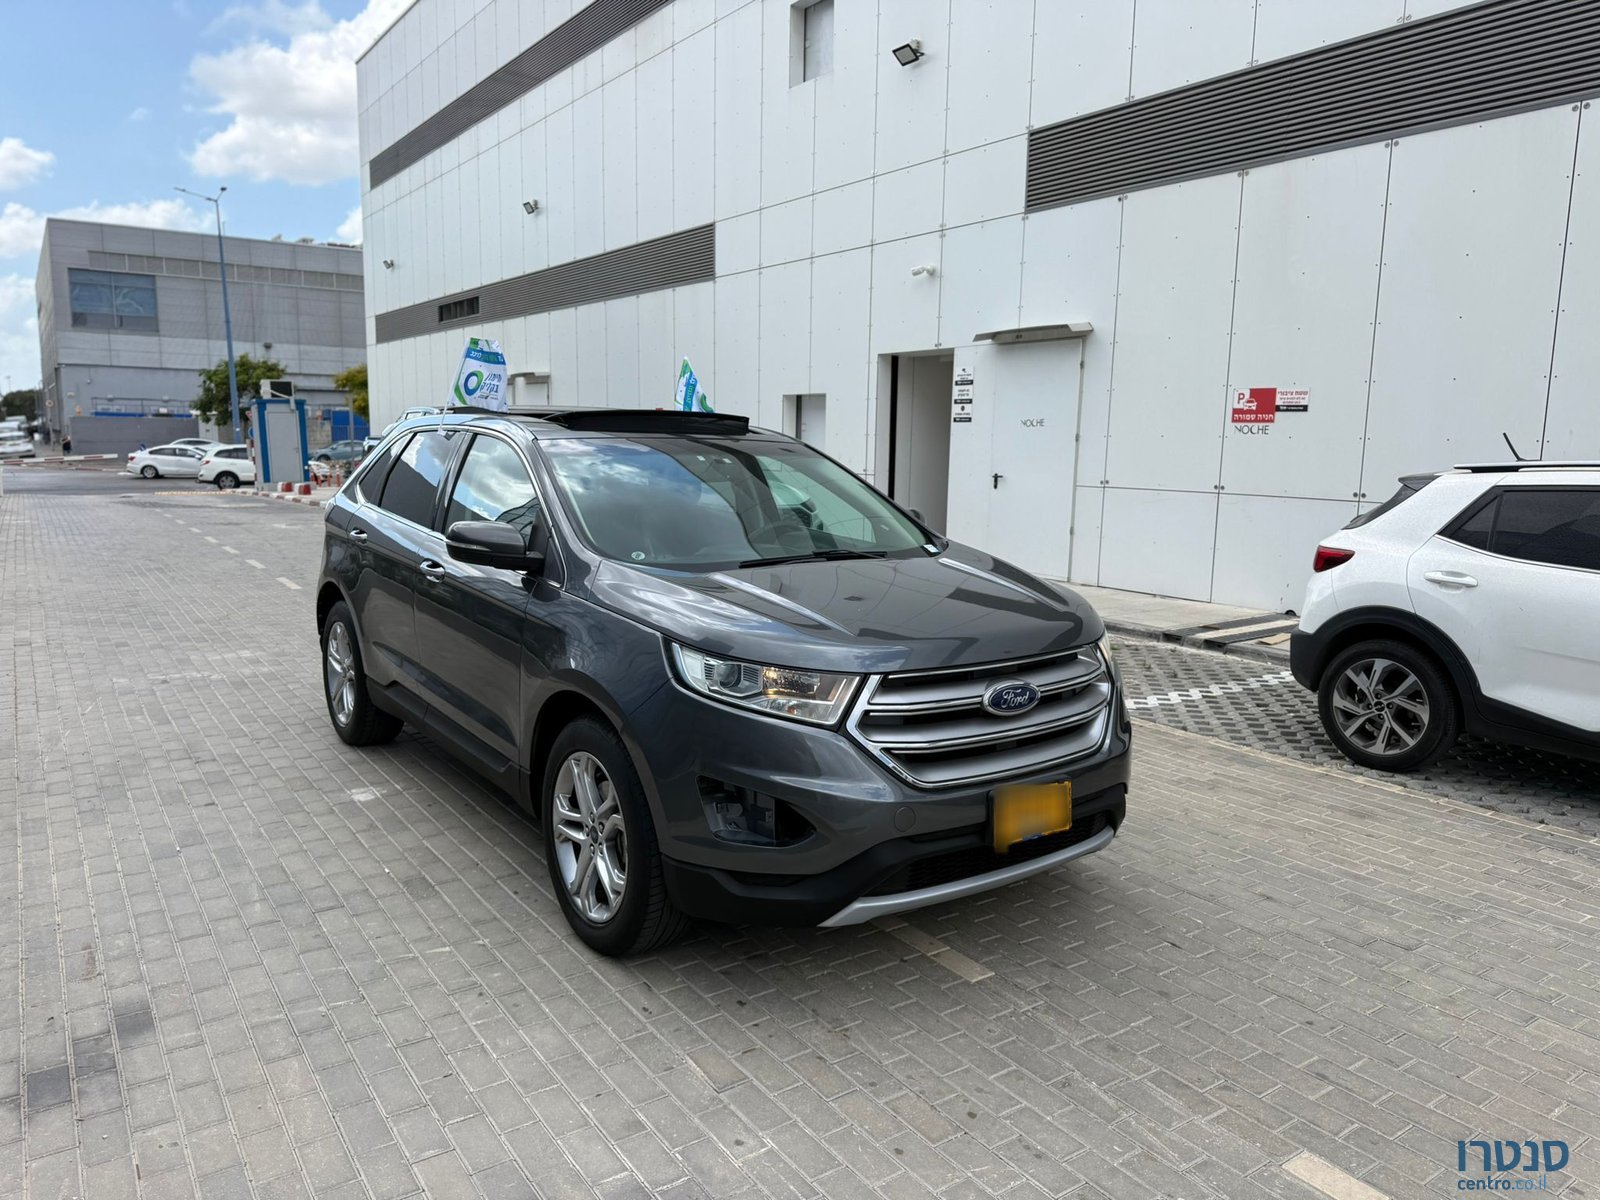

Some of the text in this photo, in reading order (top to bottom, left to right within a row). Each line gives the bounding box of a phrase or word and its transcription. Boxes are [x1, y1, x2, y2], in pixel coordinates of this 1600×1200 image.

[1233, 413, 1274, 421] חניה שמורה
[1020, 418, 1045, 428] NOCHE
[1234, 424, 1270, 435] NOCHE
[1000, 688, 1031, 709] Ford
